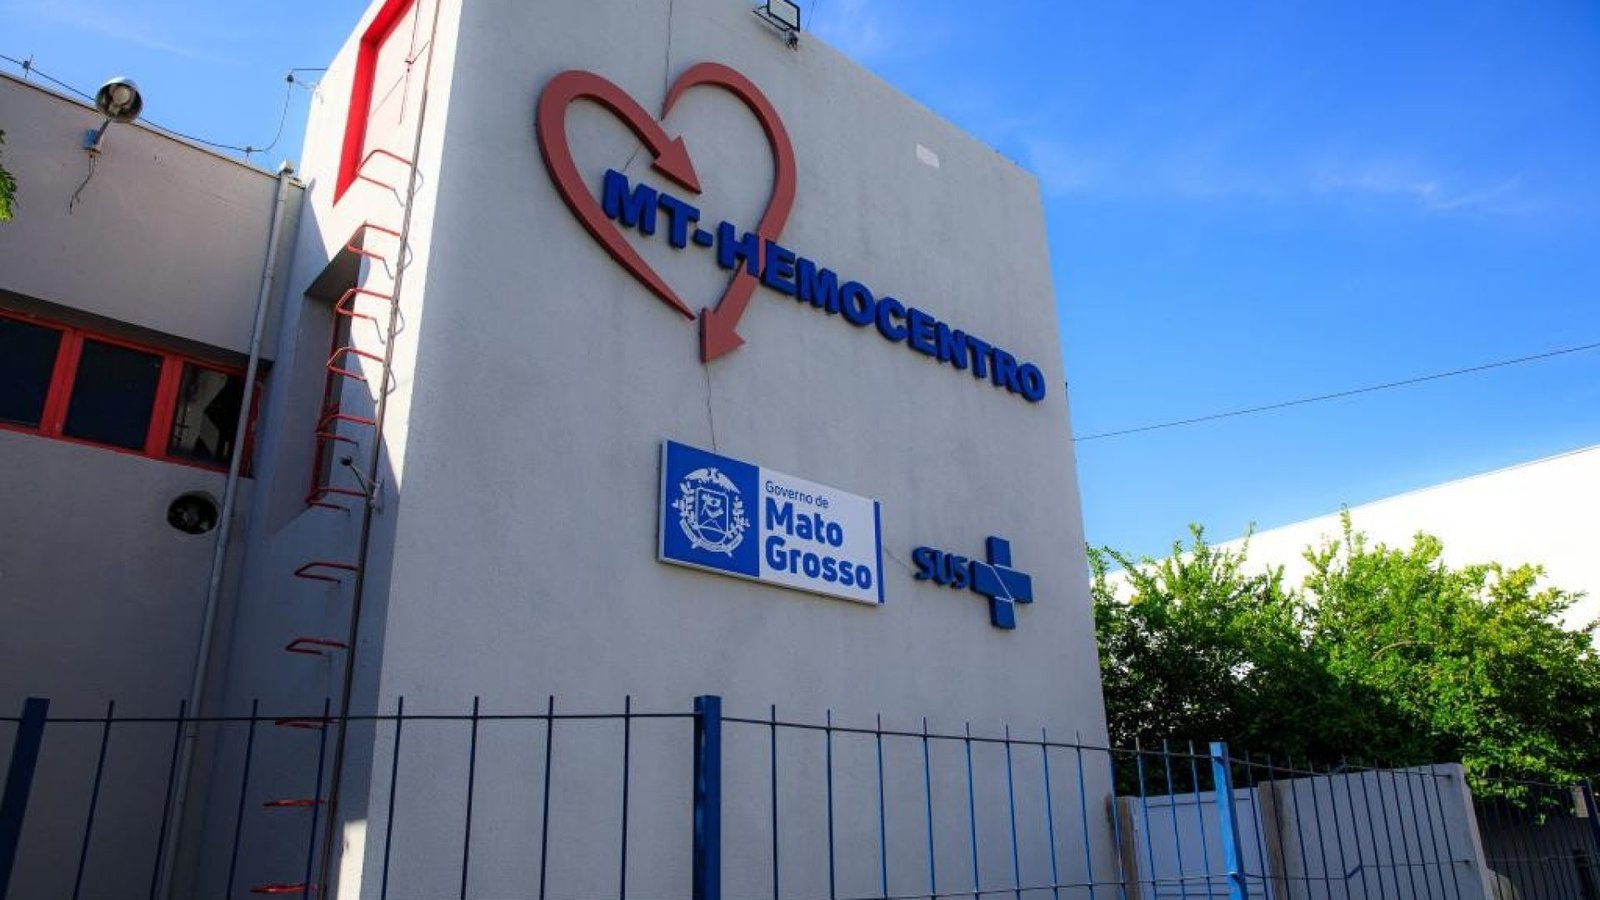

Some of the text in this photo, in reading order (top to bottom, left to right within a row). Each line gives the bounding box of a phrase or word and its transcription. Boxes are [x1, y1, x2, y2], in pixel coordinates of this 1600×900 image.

[602, 168, 1046, 402] MT-HEMOCENTRO
[765, 480, 829, 509] Governo de
[765, 496, 843, 548] Mato
[765, 535, 873, 590] Grosso
[911, 545, 970, 589] SUS
